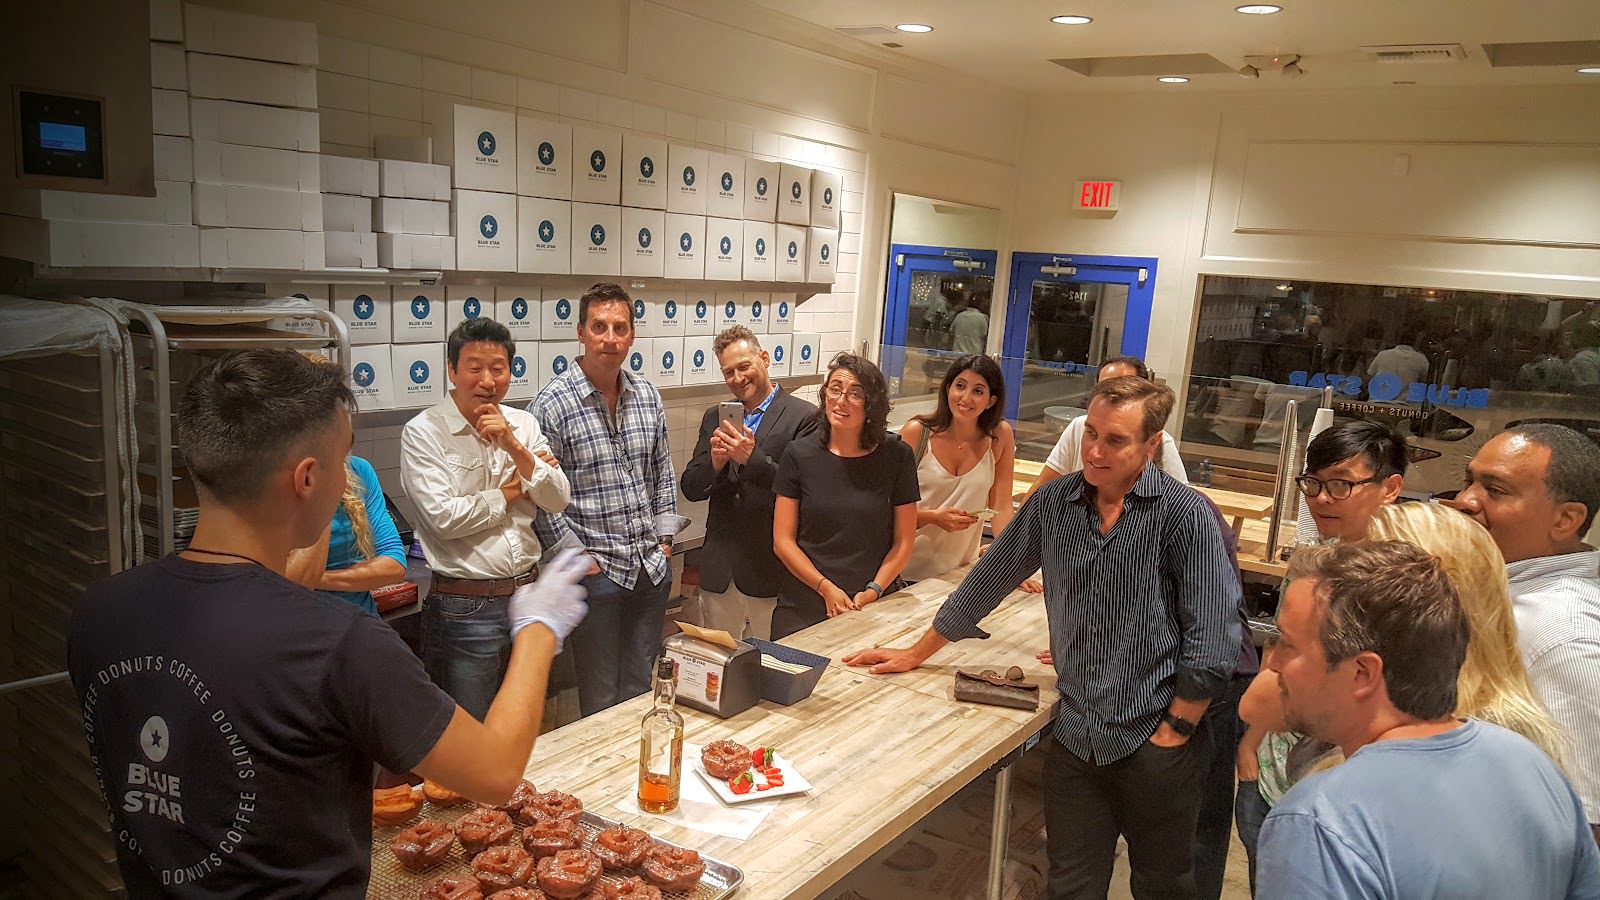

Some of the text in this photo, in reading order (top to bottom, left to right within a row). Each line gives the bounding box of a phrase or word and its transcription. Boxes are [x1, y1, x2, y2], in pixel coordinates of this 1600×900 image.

[1081, 182, 1113, 208] EXIT
[98, 656, 211, 704] DONUTS COFFEE
[212, 709, 255, 779] DONUTS
[127, 763, 181, 798] BLUE
[123, 790, 185, 824] STAR
[220, 792, 256, 854] COFFEE
[162, 852, 222, 885] DONUTS
